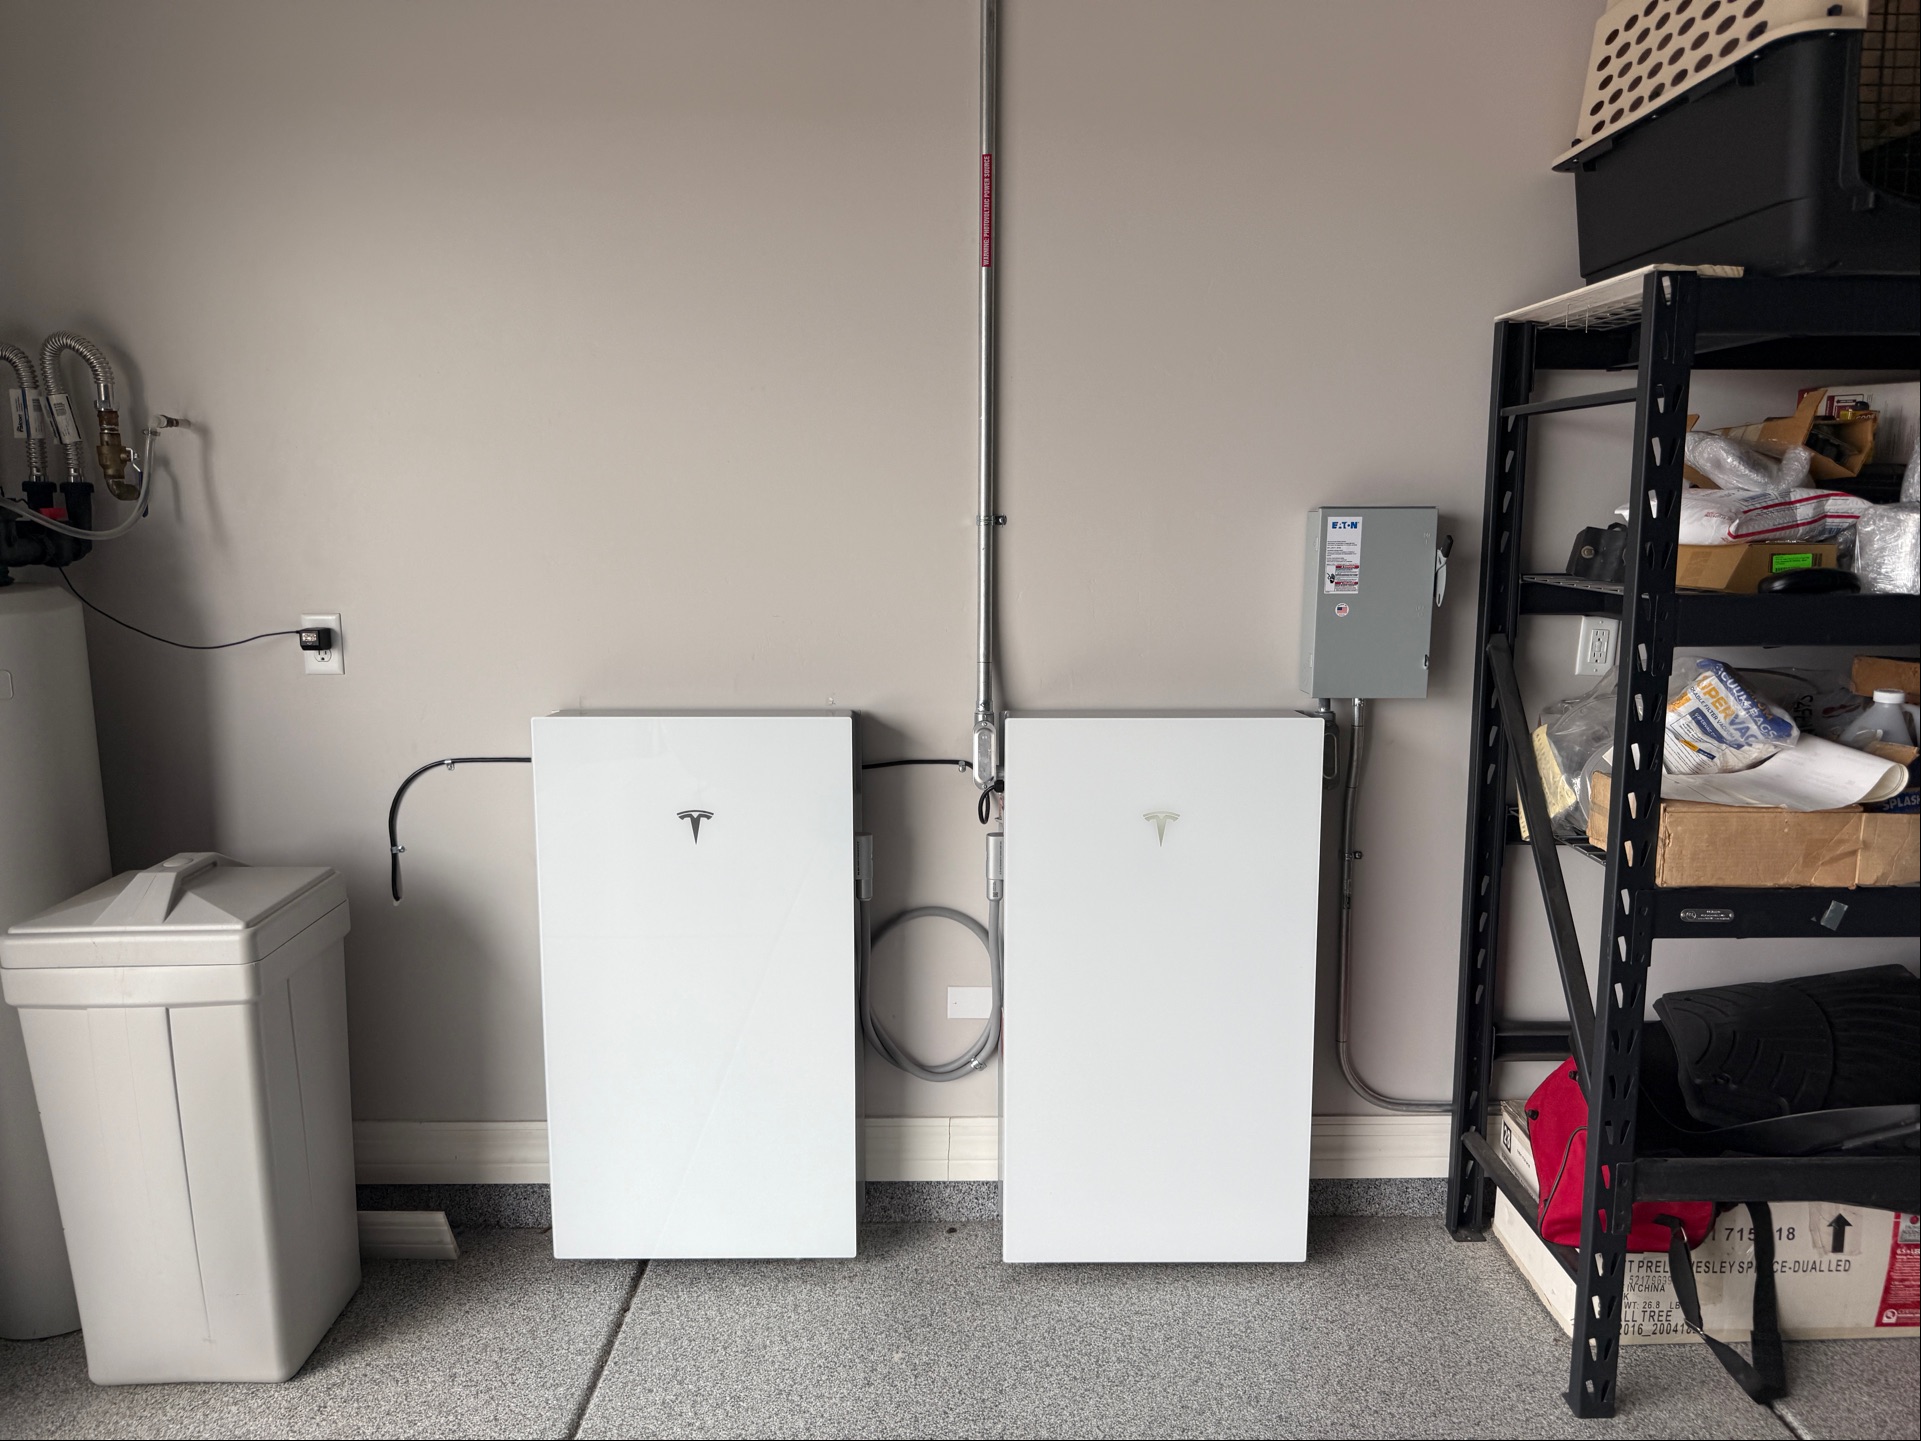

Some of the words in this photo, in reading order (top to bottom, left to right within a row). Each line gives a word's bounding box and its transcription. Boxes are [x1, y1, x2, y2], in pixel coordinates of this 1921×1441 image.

[1703, 704, 1718, 721] FILTER
[1828, 1259, 1851, 1272] LED
[1637, 1284, 1666, 1293] CHINA
[1642, 1301, 1661, 1309] 26.8
[1641, 1310, 1673, 1322] TREE
